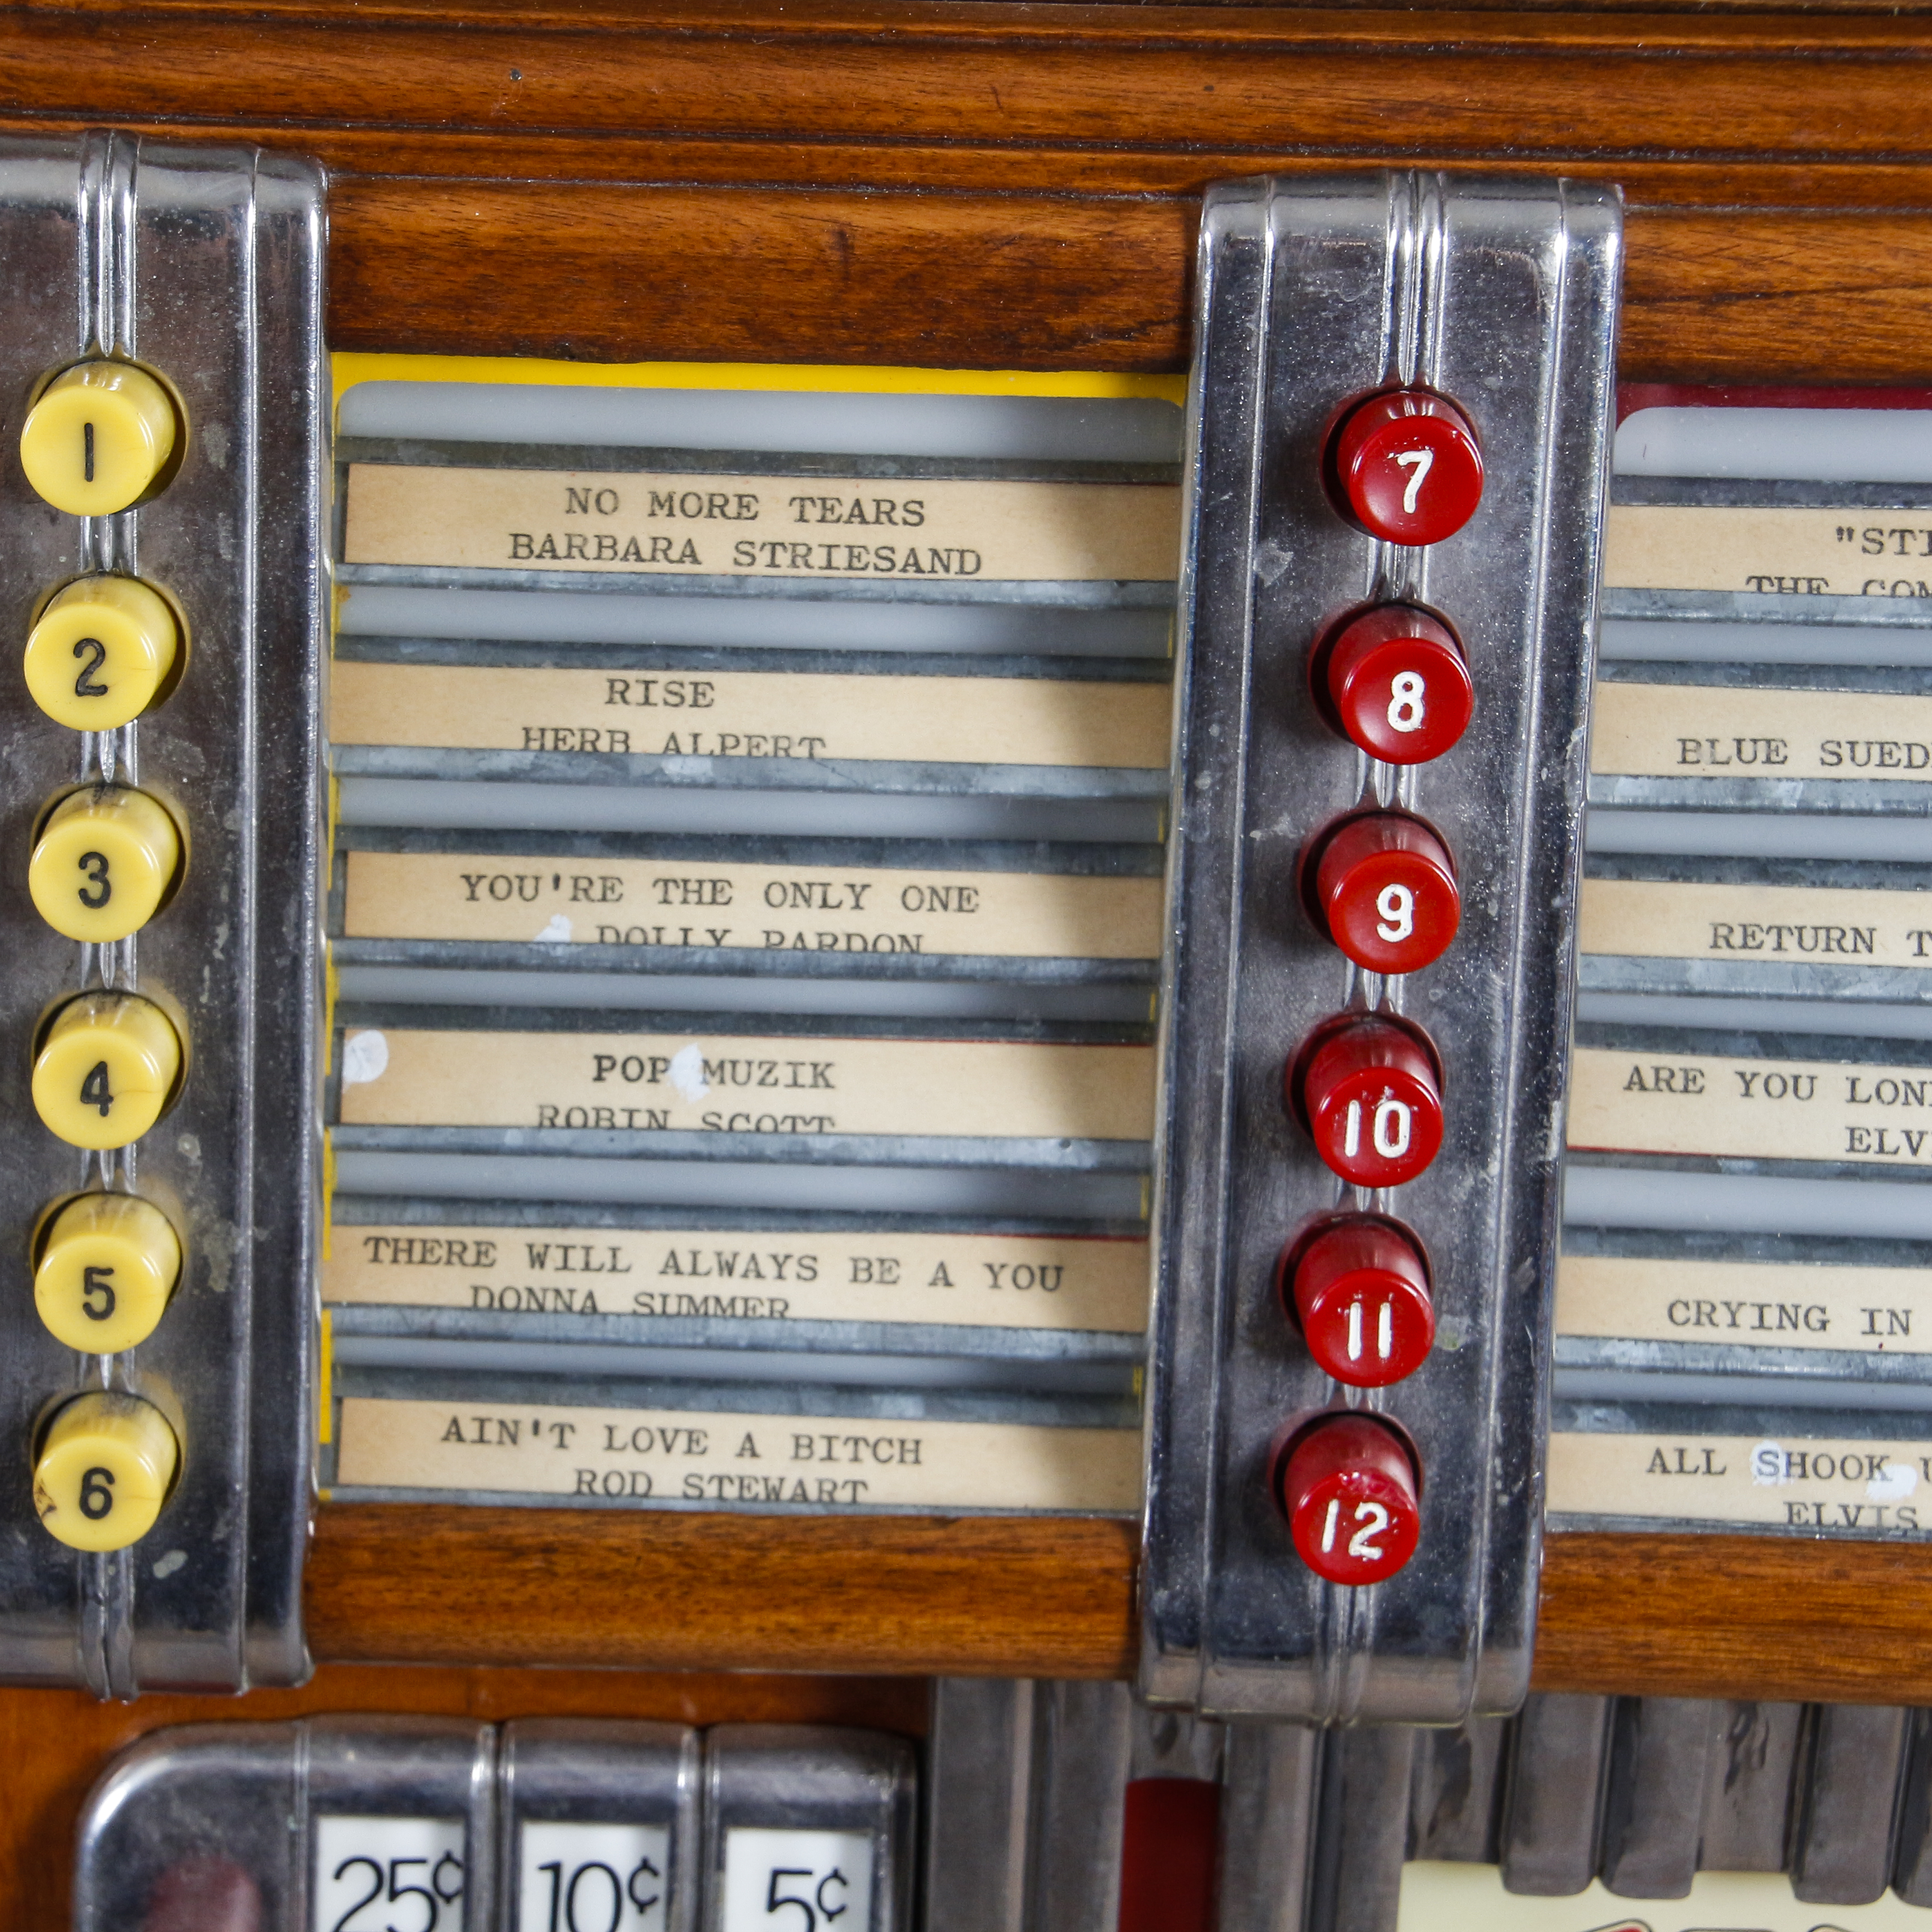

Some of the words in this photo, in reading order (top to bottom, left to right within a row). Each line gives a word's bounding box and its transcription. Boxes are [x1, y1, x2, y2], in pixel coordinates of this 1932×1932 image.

[84, 421, 94, 483] 1
[565, 488, 619, 515] NO
[648, 491, 759, 521] MORE
[789, 496, 925, 527] TEARS
[1395, 448, 1435, 515] 7
[508, 533, 702, 565] BARBARA
[733, 541, 982, 575] STRIESAND
[72, 635, 107, 698] 2
[604, 678, 715, 708] RISE
[1385, 670, 1427, 733] 8
[521, 727, 630, 752] HERB
[662, 732, 826, 758] ALPERT
[1677, 738, 1788, 765] BLUE
[1819, 740, 1932, 769] SUED
[77, 851, 111, 909] 3
[460, 873, 623, 902] YOU'RE
[652, 879, 733, 906] THE
[763, 881, 872, 911] ONLY
[901, 885, 980, 913] ONE
[1375, 881, 1415, 944] 9
[1709, 922, 1877, 954] RETURN
[80, 1060, 114, 1117] 4
[593, 1055, 671, 1082] POP
[700, 1058, 835, 1089] MUZIK
[1623, 1065, 1705, 1094] ARE
[1735, 1071, 1818, 1101] YOU
[1845, 1076, 1932, 1107] LON
[537, 1104, 671, 1130] ROBIN
[702, 1112, 835, 1134] SCOTT
[1344, 1100, 1410, 1157] 10
[1845, 1127, 1932, 1157] ELV
[363, 1236, 497, 1268] THERE
[525, 1243, 632, 1272] WILL
[658, 1249, 818, 1281] ALWAYS
[849, 1256, 900, 1285] BE
[928, 1261, 954, 1288] A
[983, 1263, 1064, 1292] YOU
[82, 1266, 115, 1321] 5
[470, 1285, 600, 1313] DONNA
[631, 1292, 790, 1318] SUMMER
[1667, 1299, 1830, 1332] CRYING
[1860, 1308, 1912, 1335] IN
[1348, 1301, 1391, 1361] 11
[441, 1414, 575, 1450] AIN'T
[603, 1424, 708, 1456] LOVE
[735, 1432, 762, 1459] A
[792, 1432, 923, 1466] BITCH
[1646, 1447, 1727, 1476] ALL
[1756, 1450, 1893, 1482] SHOOK
[79, 1467, 115, 1519] 6
[573, 1468, 652, 1497] ROD
[682, 1473, 869, 1504] STEWART
[1322, 1498, 1386, 1559] 12
[1783, 1501, 1918, 1531] ELVIS
[333, 1849, 462, 1932] 25¢
[538, 1855, 659, 1932] 10¢
[767, 1868, 847, 1932] 5¢
